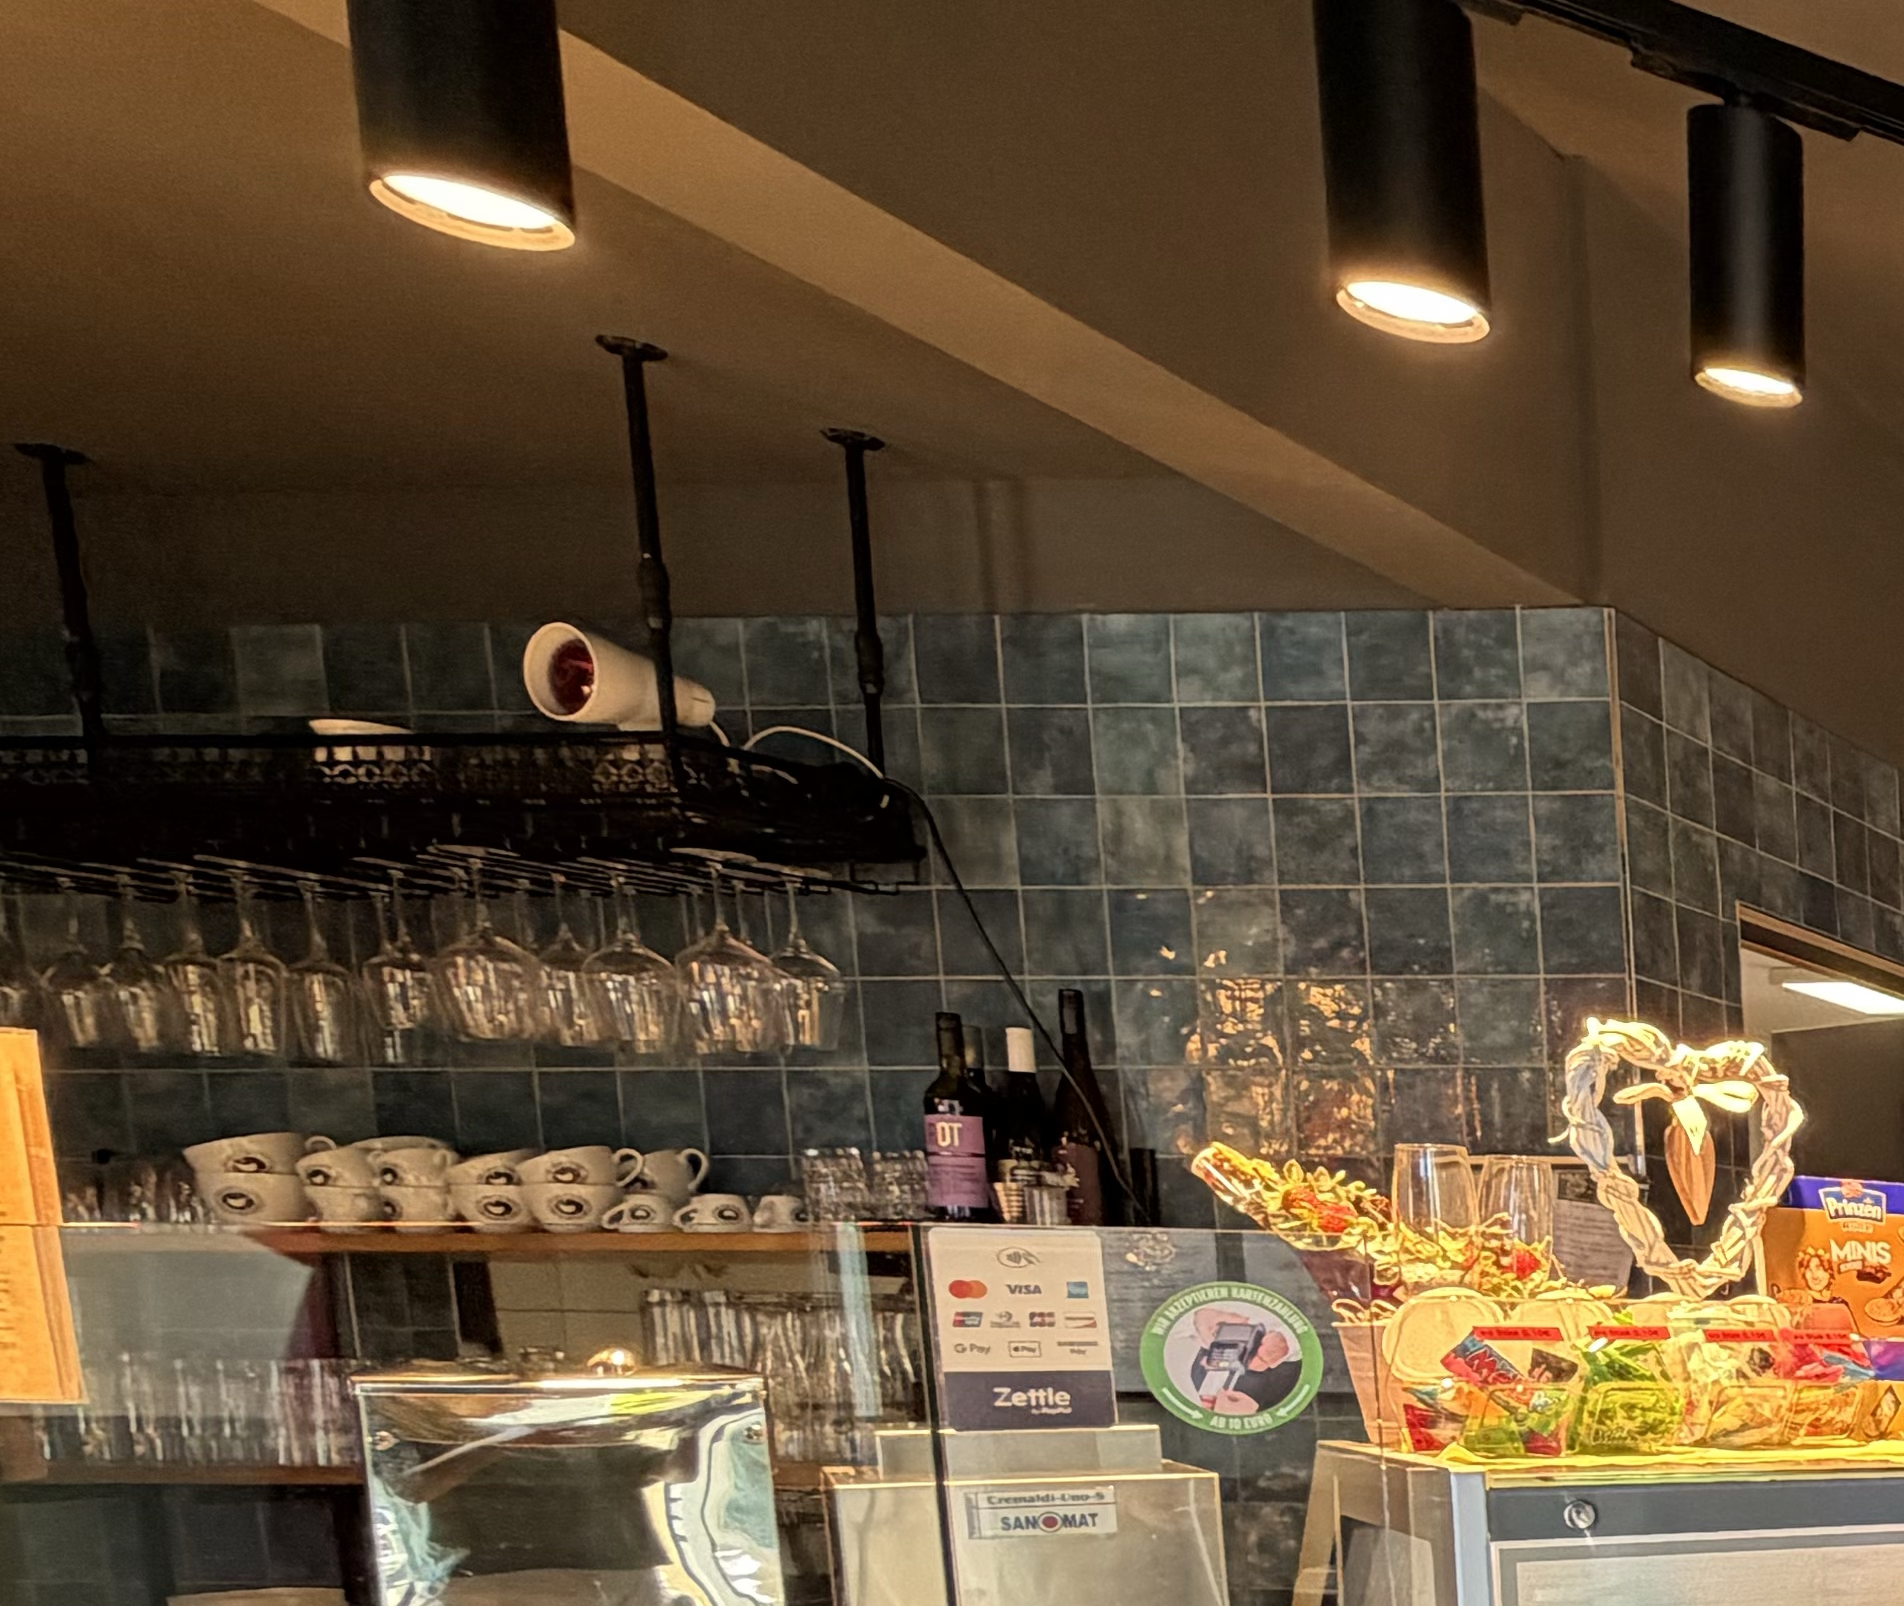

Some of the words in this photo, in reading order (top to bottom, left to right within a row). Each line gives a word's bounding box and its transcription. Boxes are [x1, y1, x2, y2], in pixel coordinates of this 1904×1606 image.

[1825, 1197, 1882, 1220] Prinzen
[1830, 1239, 1892, 1265] MINIS
[1005, 1284, 1042, 1295] VISA
[993, 1387, 1071, 1407] Zettle
[1229, 1417, 1241, 1429] 10
